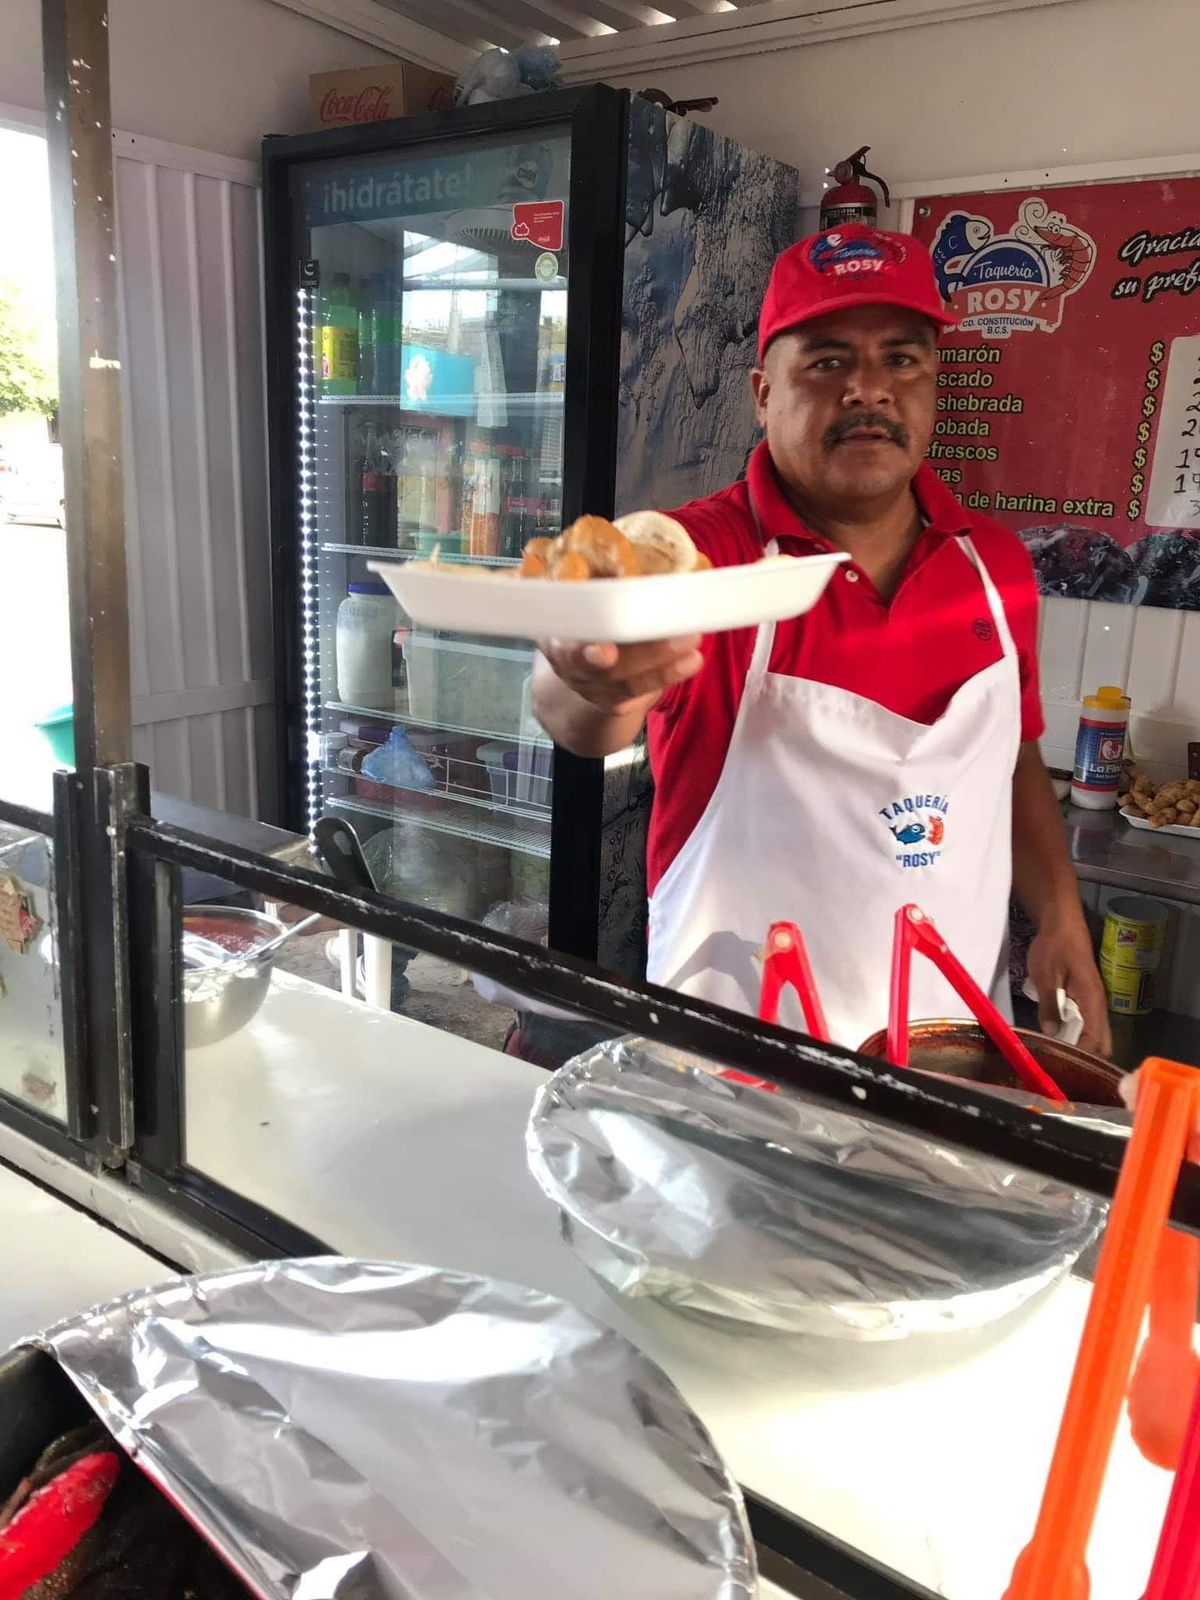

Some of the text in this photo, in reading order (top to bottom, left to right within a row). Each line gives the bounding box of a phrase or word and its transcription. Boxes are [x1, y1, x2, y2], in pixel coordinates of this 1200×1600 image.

[834, 259, 884, 275] ROSY
[1114, 260, 1200, 301] su pref
[967, 287, 1041, 314] ROSY
[962, 319, 976, 328] CD.
[987, 326, 1009, 335] B.C.S.
[1150, 341, 1164, 365] $
[936, 369, 993, 387] scado
[1146, 368, 1160, 391] $
[1142, 394, 1156, 417] $
[934, 418, 990, 436] obada
[1137, 418, 1200, 444] $ 2
[1134, 447, 1147, 470] $
[1131, 473, 1144, 495] $
[968, 490, 990, 508] de
[995, 491, 1056, 513] harina
[1062, 497, 1114, 517] extra
[1127, 499, 1140, 520] $
